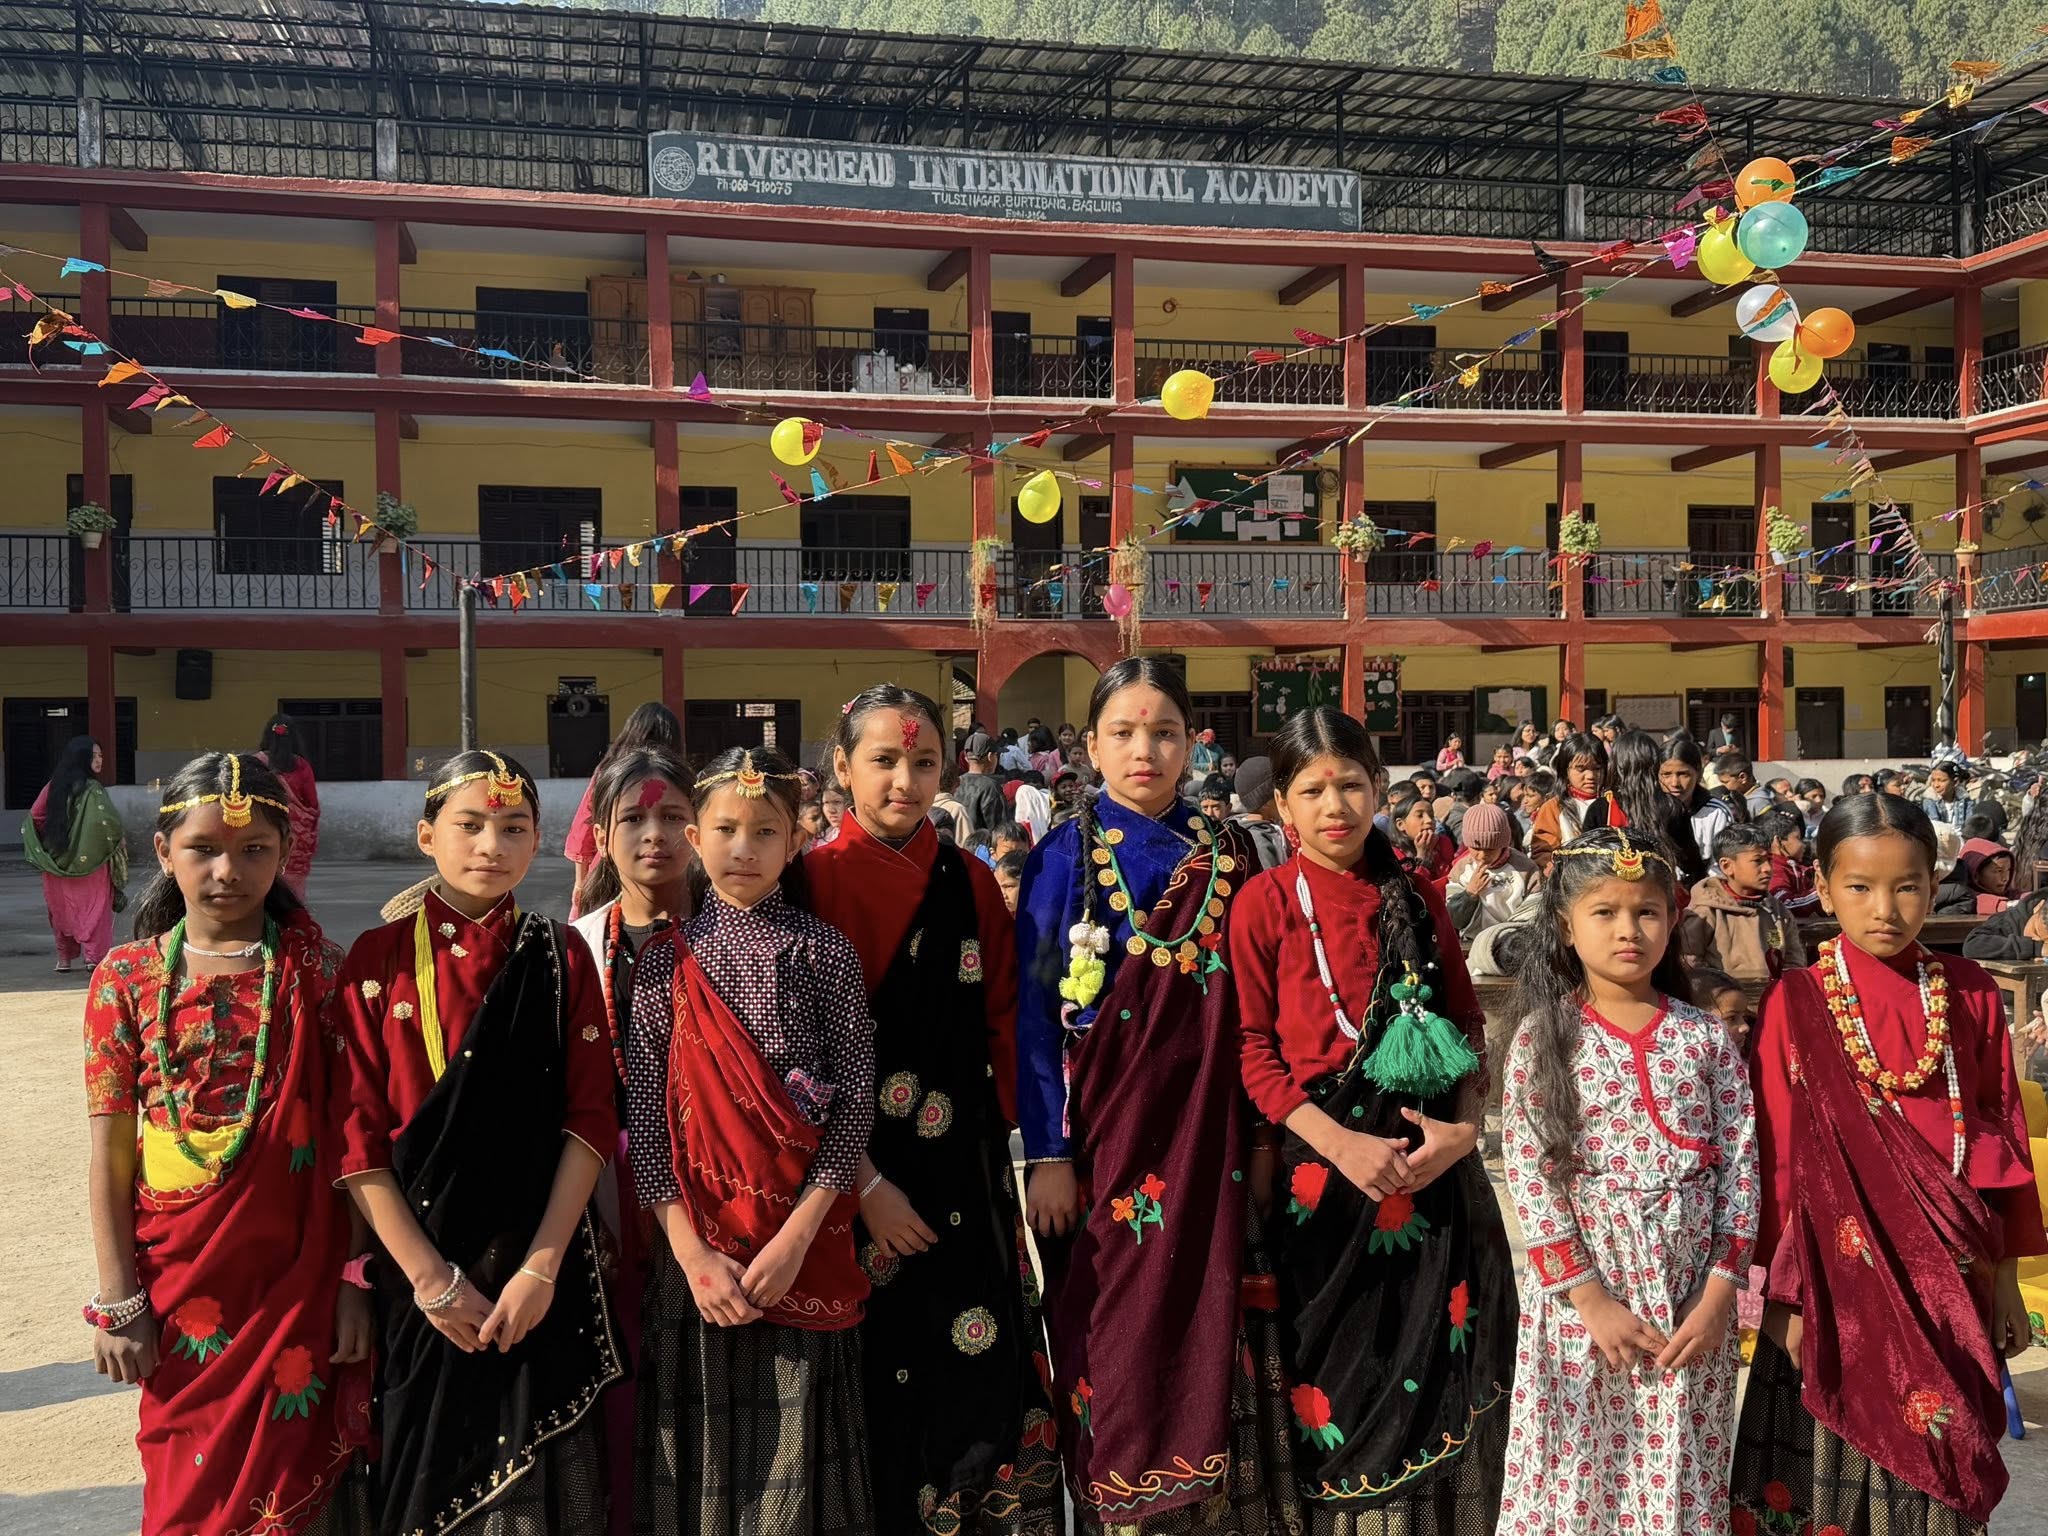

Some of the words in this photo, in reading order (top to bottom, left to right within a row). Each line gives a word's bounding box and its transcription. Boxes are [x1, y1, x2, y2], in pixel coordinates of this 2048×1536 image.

[696, 141, 896, 188] RIVERHEAD
[908, 155, 1195, 203] INTERNATIONAL
[1202, 169, 1359, 208] ACADEMY
[1072, 199, 1122, 213] BAGLUNG
